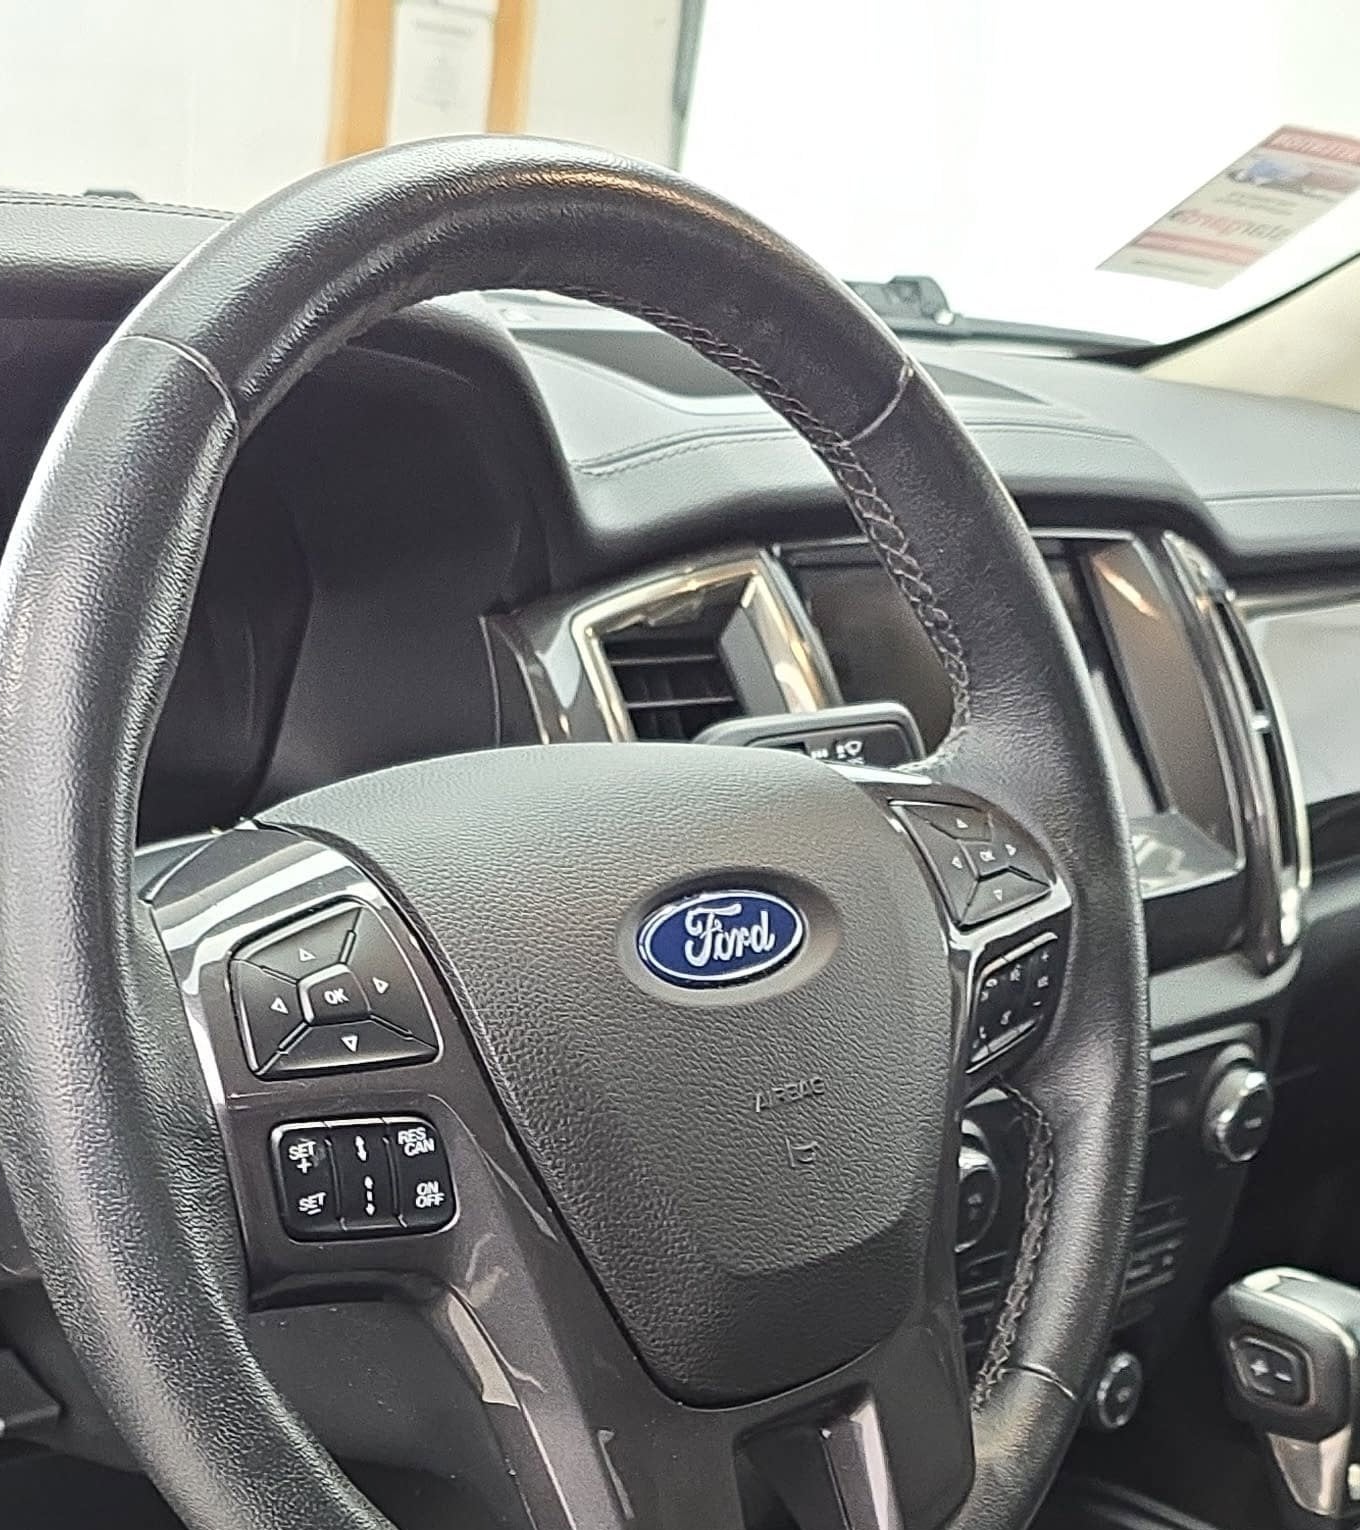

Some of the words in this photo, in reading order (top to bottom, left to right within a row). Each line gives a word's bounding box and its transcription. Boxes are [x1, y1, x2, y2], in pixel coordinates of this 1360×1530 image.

[684, 903, 776, 967] Ford
[324, 988, 350, 1005] OK
[397, 1127, 428, 1145] RES
[288, 1140, 317, 1161] SET
[404, 1138, 435, 1157] CAN
[416, 1180, 439, 1195] ON
[297, 1192, 327, 1212] SET
[415, 1193, 446, 1208] OFF
